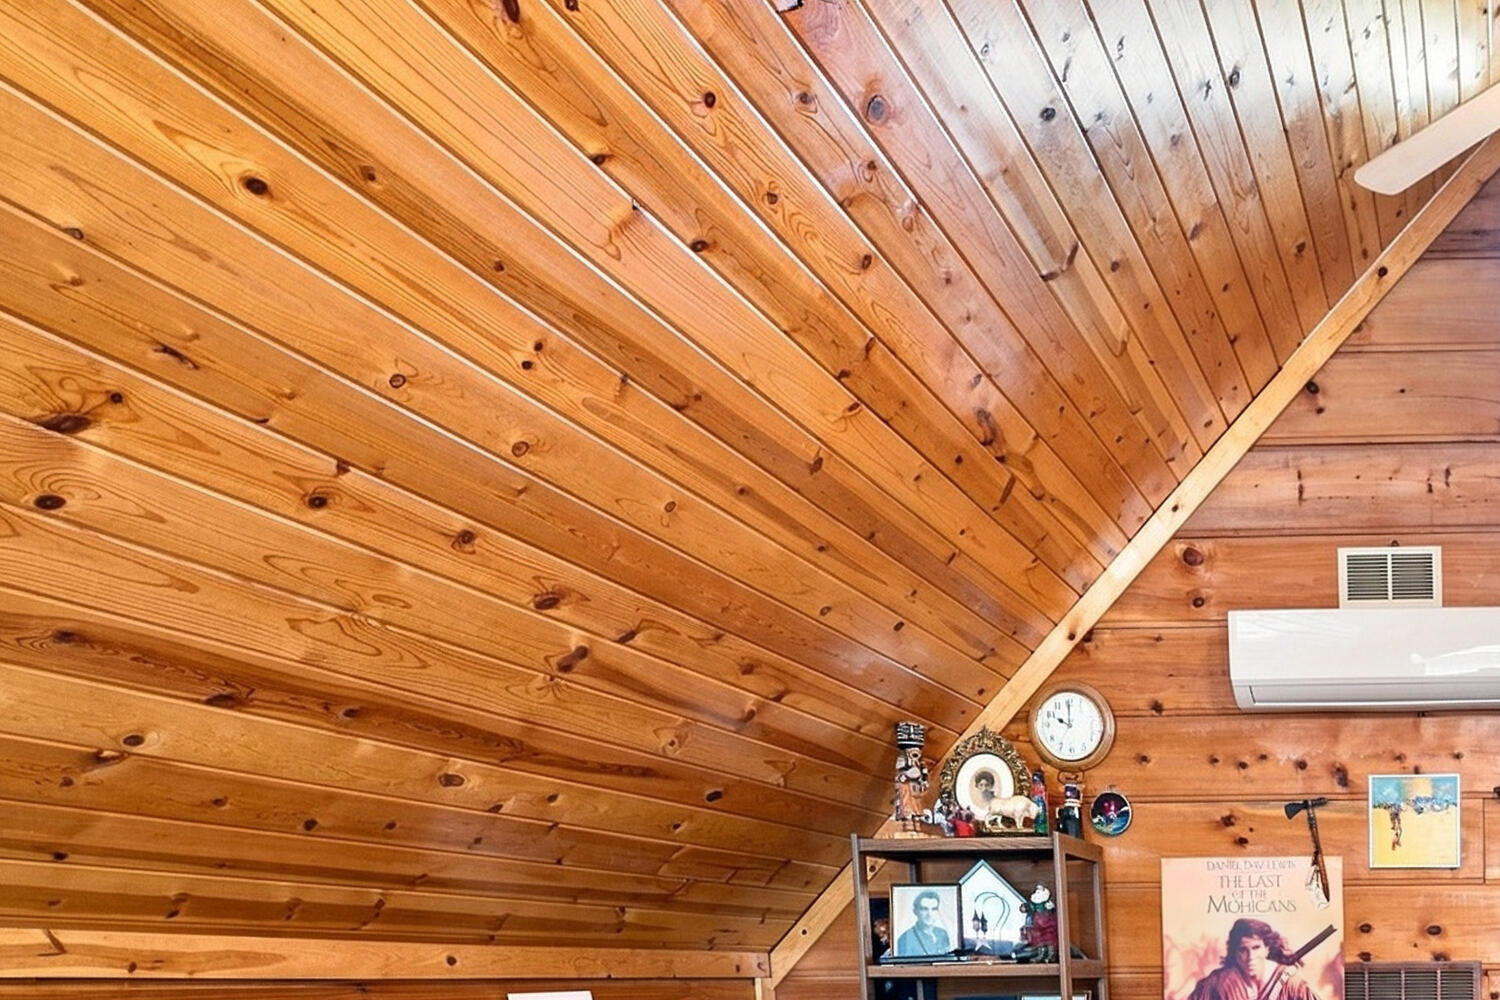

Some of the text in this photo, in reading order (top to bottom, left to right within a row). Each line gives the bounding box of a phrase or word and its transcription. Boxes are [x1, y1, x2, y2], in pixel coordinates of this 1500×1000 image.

[1220, 874, 1281, 888] THE LAST
[1231, 889, 1244, 899] OF
[1207, 895, 1297, 914] MOHICANS
